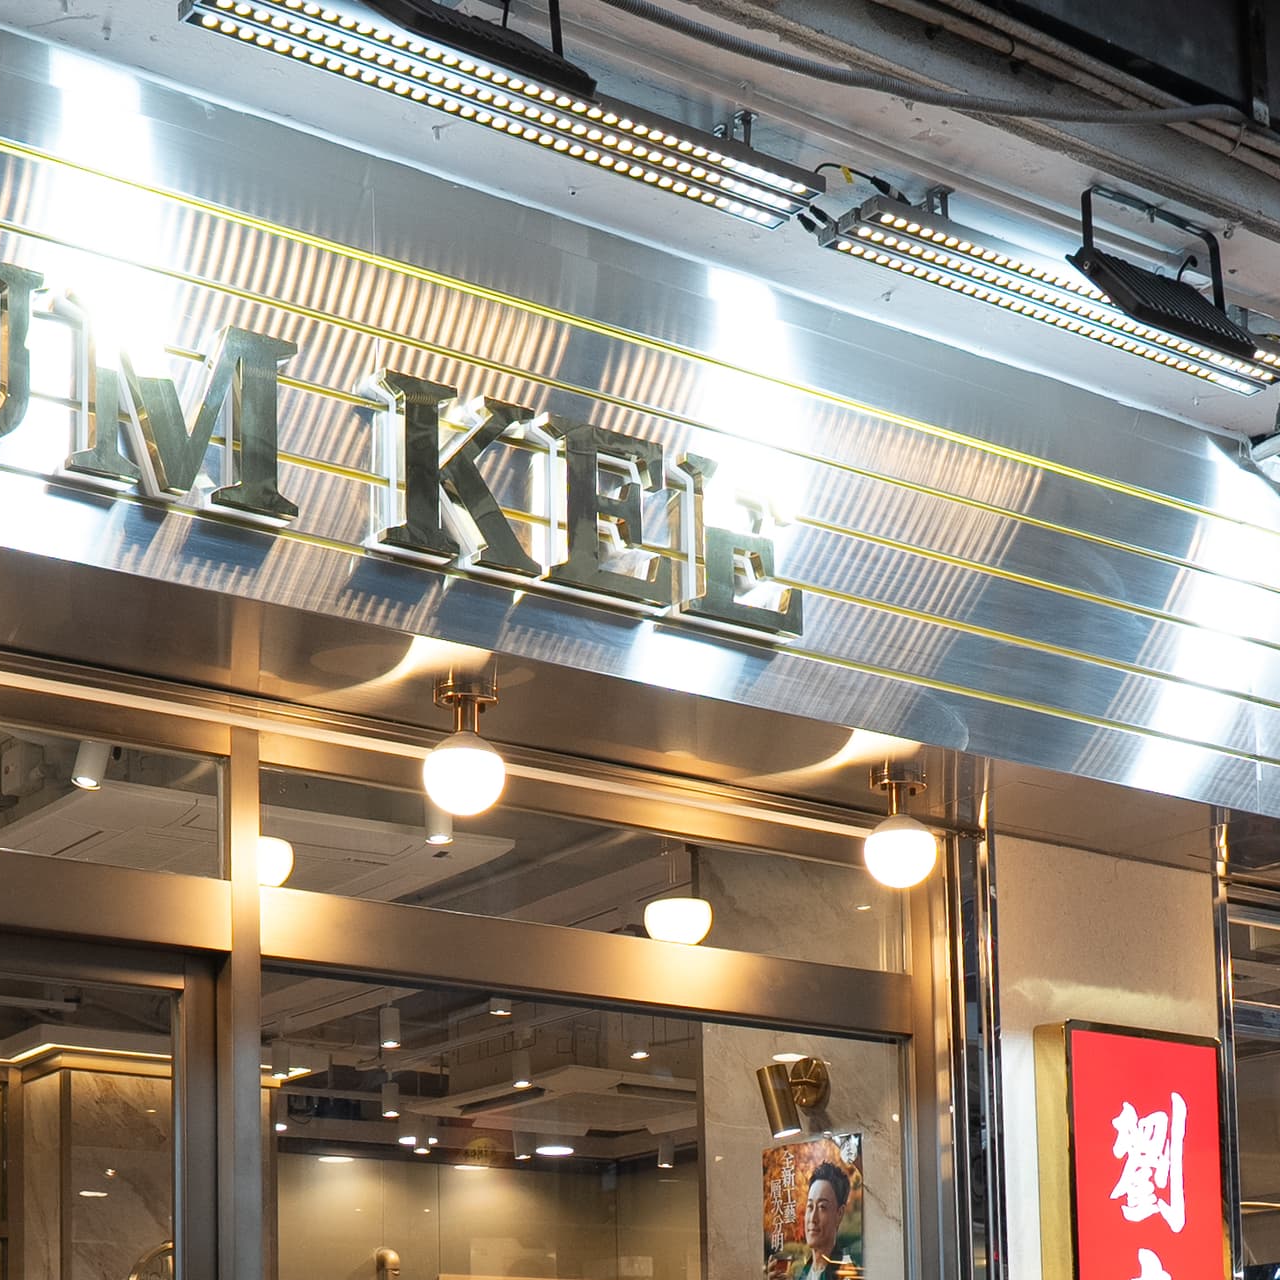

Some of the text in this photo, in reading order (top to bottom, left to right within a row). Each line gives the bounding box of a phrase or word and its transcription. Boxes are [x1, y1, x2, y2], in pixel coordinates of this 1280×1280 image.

[360, 366, 804, 640] KEE
[770, 1180, 785, 1252] 層次分明
[781, 1150, 798, 1225] 全新工藝
